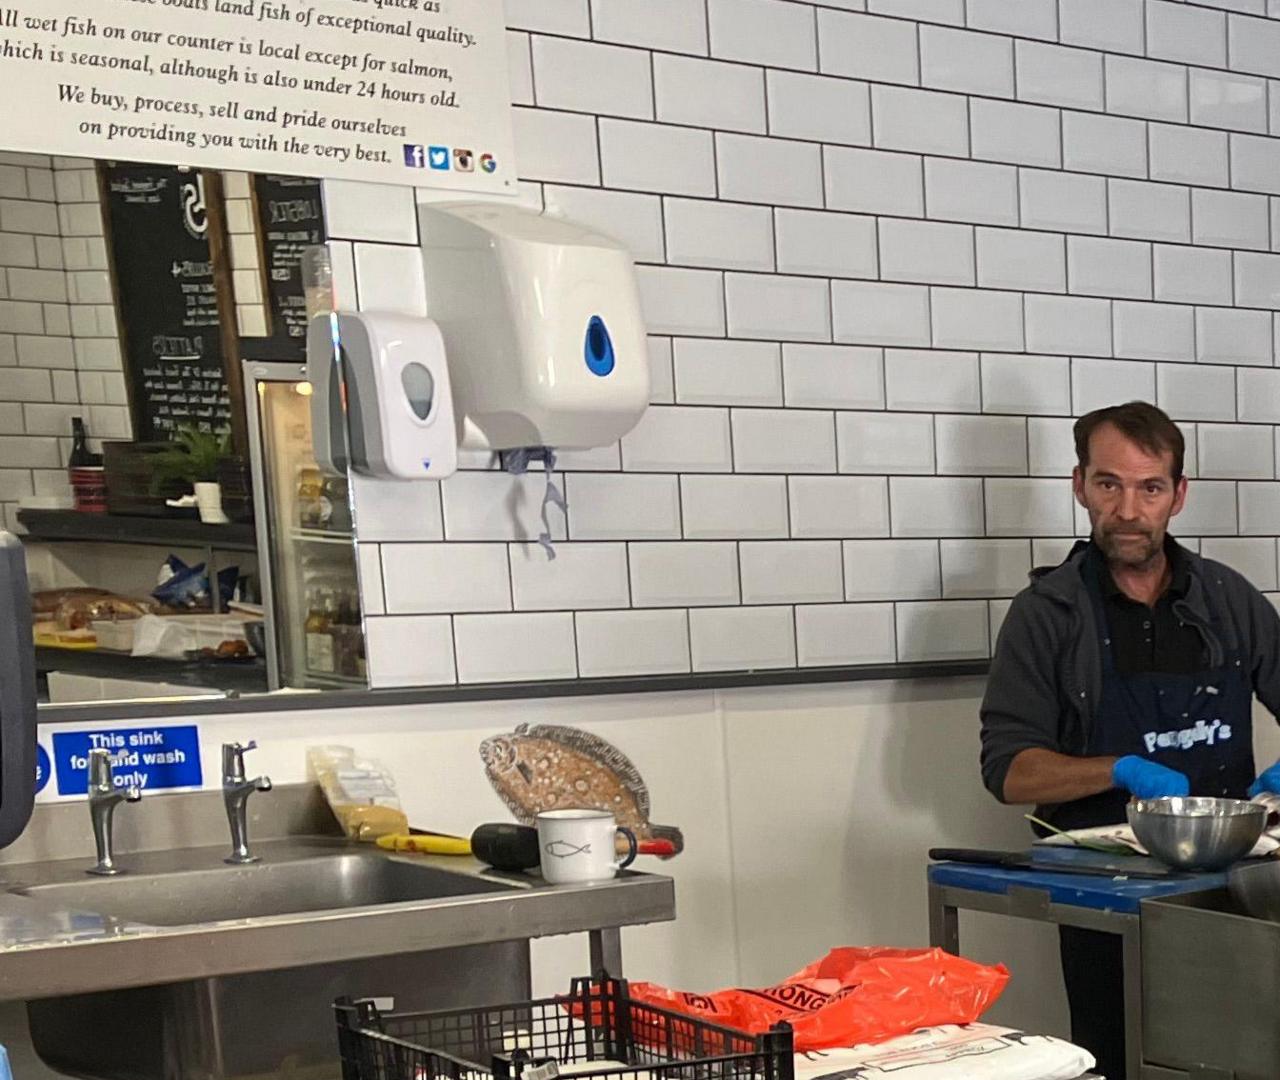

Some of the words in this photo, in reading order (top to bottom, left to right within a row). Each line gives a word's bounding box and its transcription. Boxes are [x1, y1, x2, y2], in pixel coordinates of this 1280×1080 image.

[215, 0, 254, 16] land
[257, 1, 290, 22] fish
[296, 8, 315, 27] of
[317, 15, 411, 37] exceptional
[416, 26, 477, 48] quality.
[423, 1, 440, 13] as
[24, 16, 57, 32] wet
[61, 16, 96, 37] fish
[103, 26, 125, 39] on
[131, 29, 162, 43] our
[167, 32, 233, 51] counter
[239, 36, 252, 54] is
[259, 40, 300, 61] local
[305, 52, 357, 71] except
[361, 53, 386, 73] for
[391, 58, 453, 82] salmon,
[0, 39, 43, 61] hich
[50, 44, 64, 63] is
[70, 51, 154, 76] seasonal,
[160, 58, 239, 84] although
[244, 67, 257, 84] is
[263, 69, 298, 88] also
[303, 77, 352, 95] under
[356, 80, 375, 98] 24
[381, 83, 425, 104] hours
[430, 91, 460, 108] old.
[57, 84, 85, 103] We
[91, 87, 128, 111] buy,
[134, 96, 204, 118] process,
[209, 102, 239, 119] sell
[244, 107, 277, 123] and
[282, 110, 326, 129] pride
[331, 118, 407, 137] ourselves
[79, 121, 101, 134] on
[107, 122, 196, 147] providing
[200, 134, 233, 148] you
[238, 133, 277, 151] with
[283, 137, 309, 154] the
[313, 144, 350, 163] very
[356, 144, 392, 163] best.
[70, 755, 88, 770] fo
[111, 752, 139, 767] and
[143, 750, 185, 765] wash
[89, 733, 125, 748] This
[129, 731, 163, 746] sink
[113, 771, 148, 787] only
